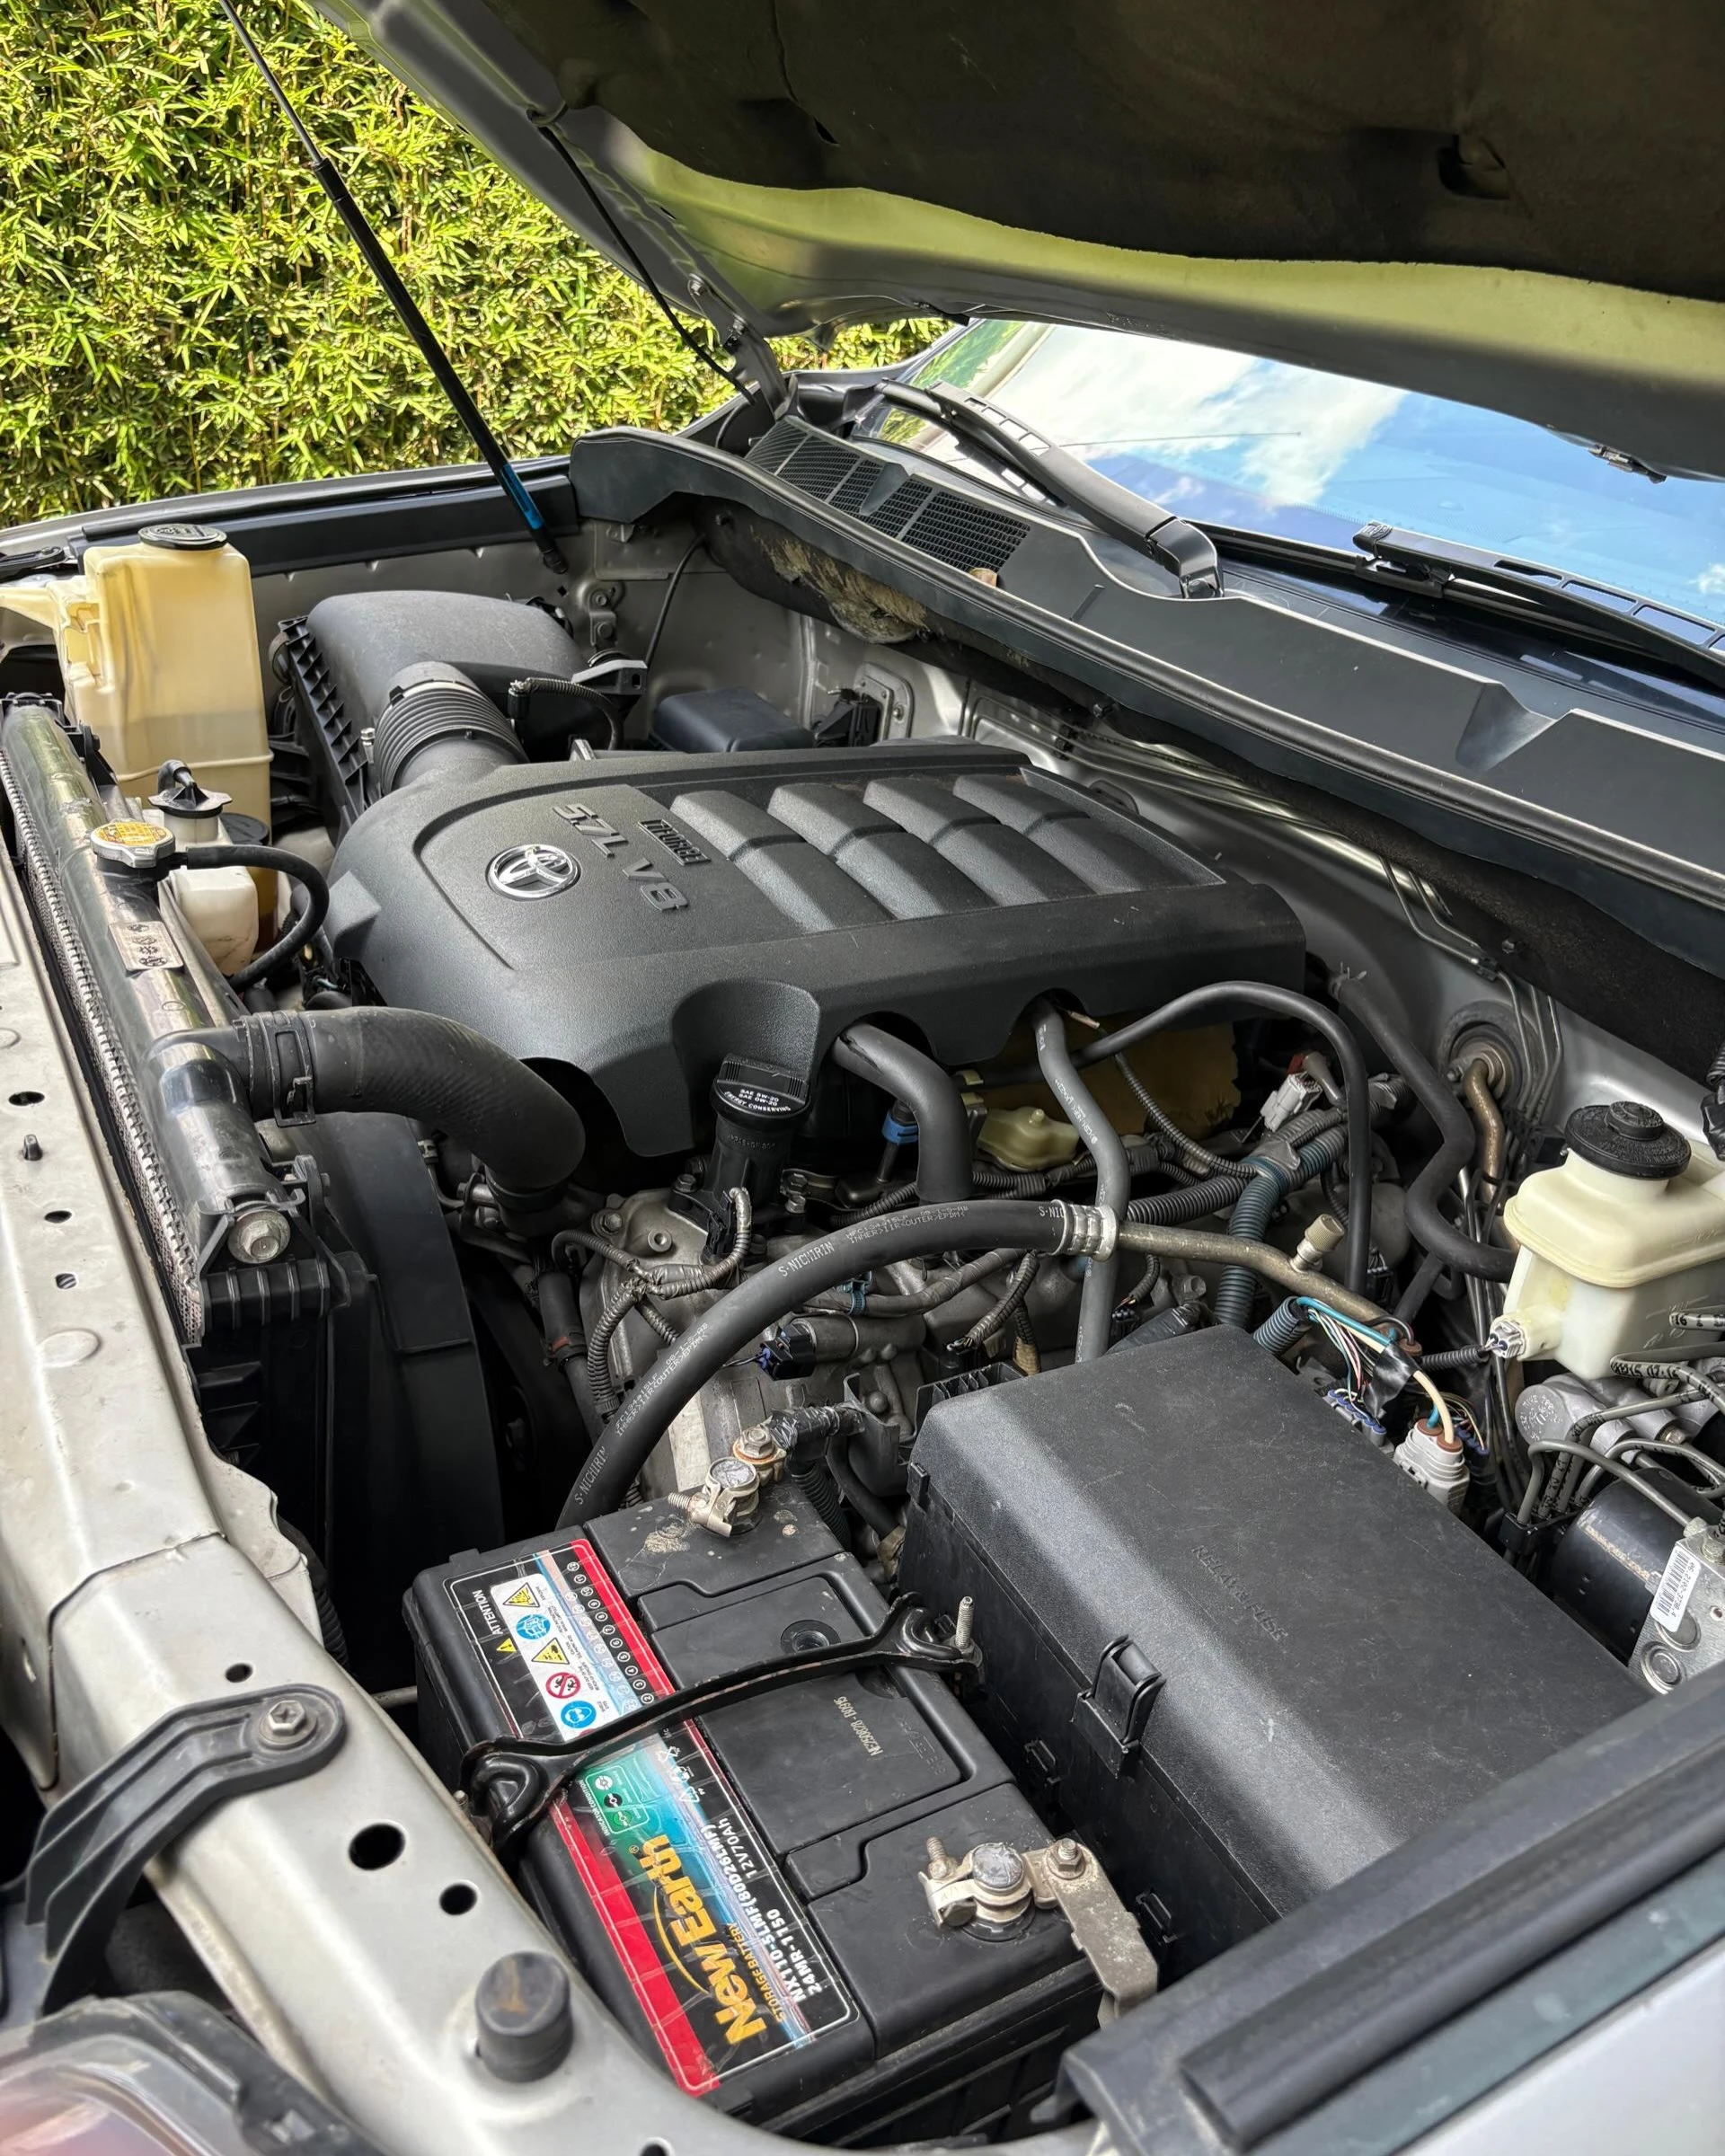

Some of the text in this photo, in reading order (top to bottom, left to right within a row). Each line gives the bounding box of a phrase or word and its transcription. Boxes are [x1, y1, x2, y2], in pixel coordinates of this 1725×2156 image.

[622, 857, 690, 912] V8
[472, 1589, 504, 1636] ATTENTION
[579, 1779, 611, 1836] INDICATOR CONDITION
[639, 1833, 767, 2046] New Earth
[717, 1817, 823, 1996] 24MR-1150 12V70Ah
[725, 1922, 787, 2022] STORAGE BATTERY
